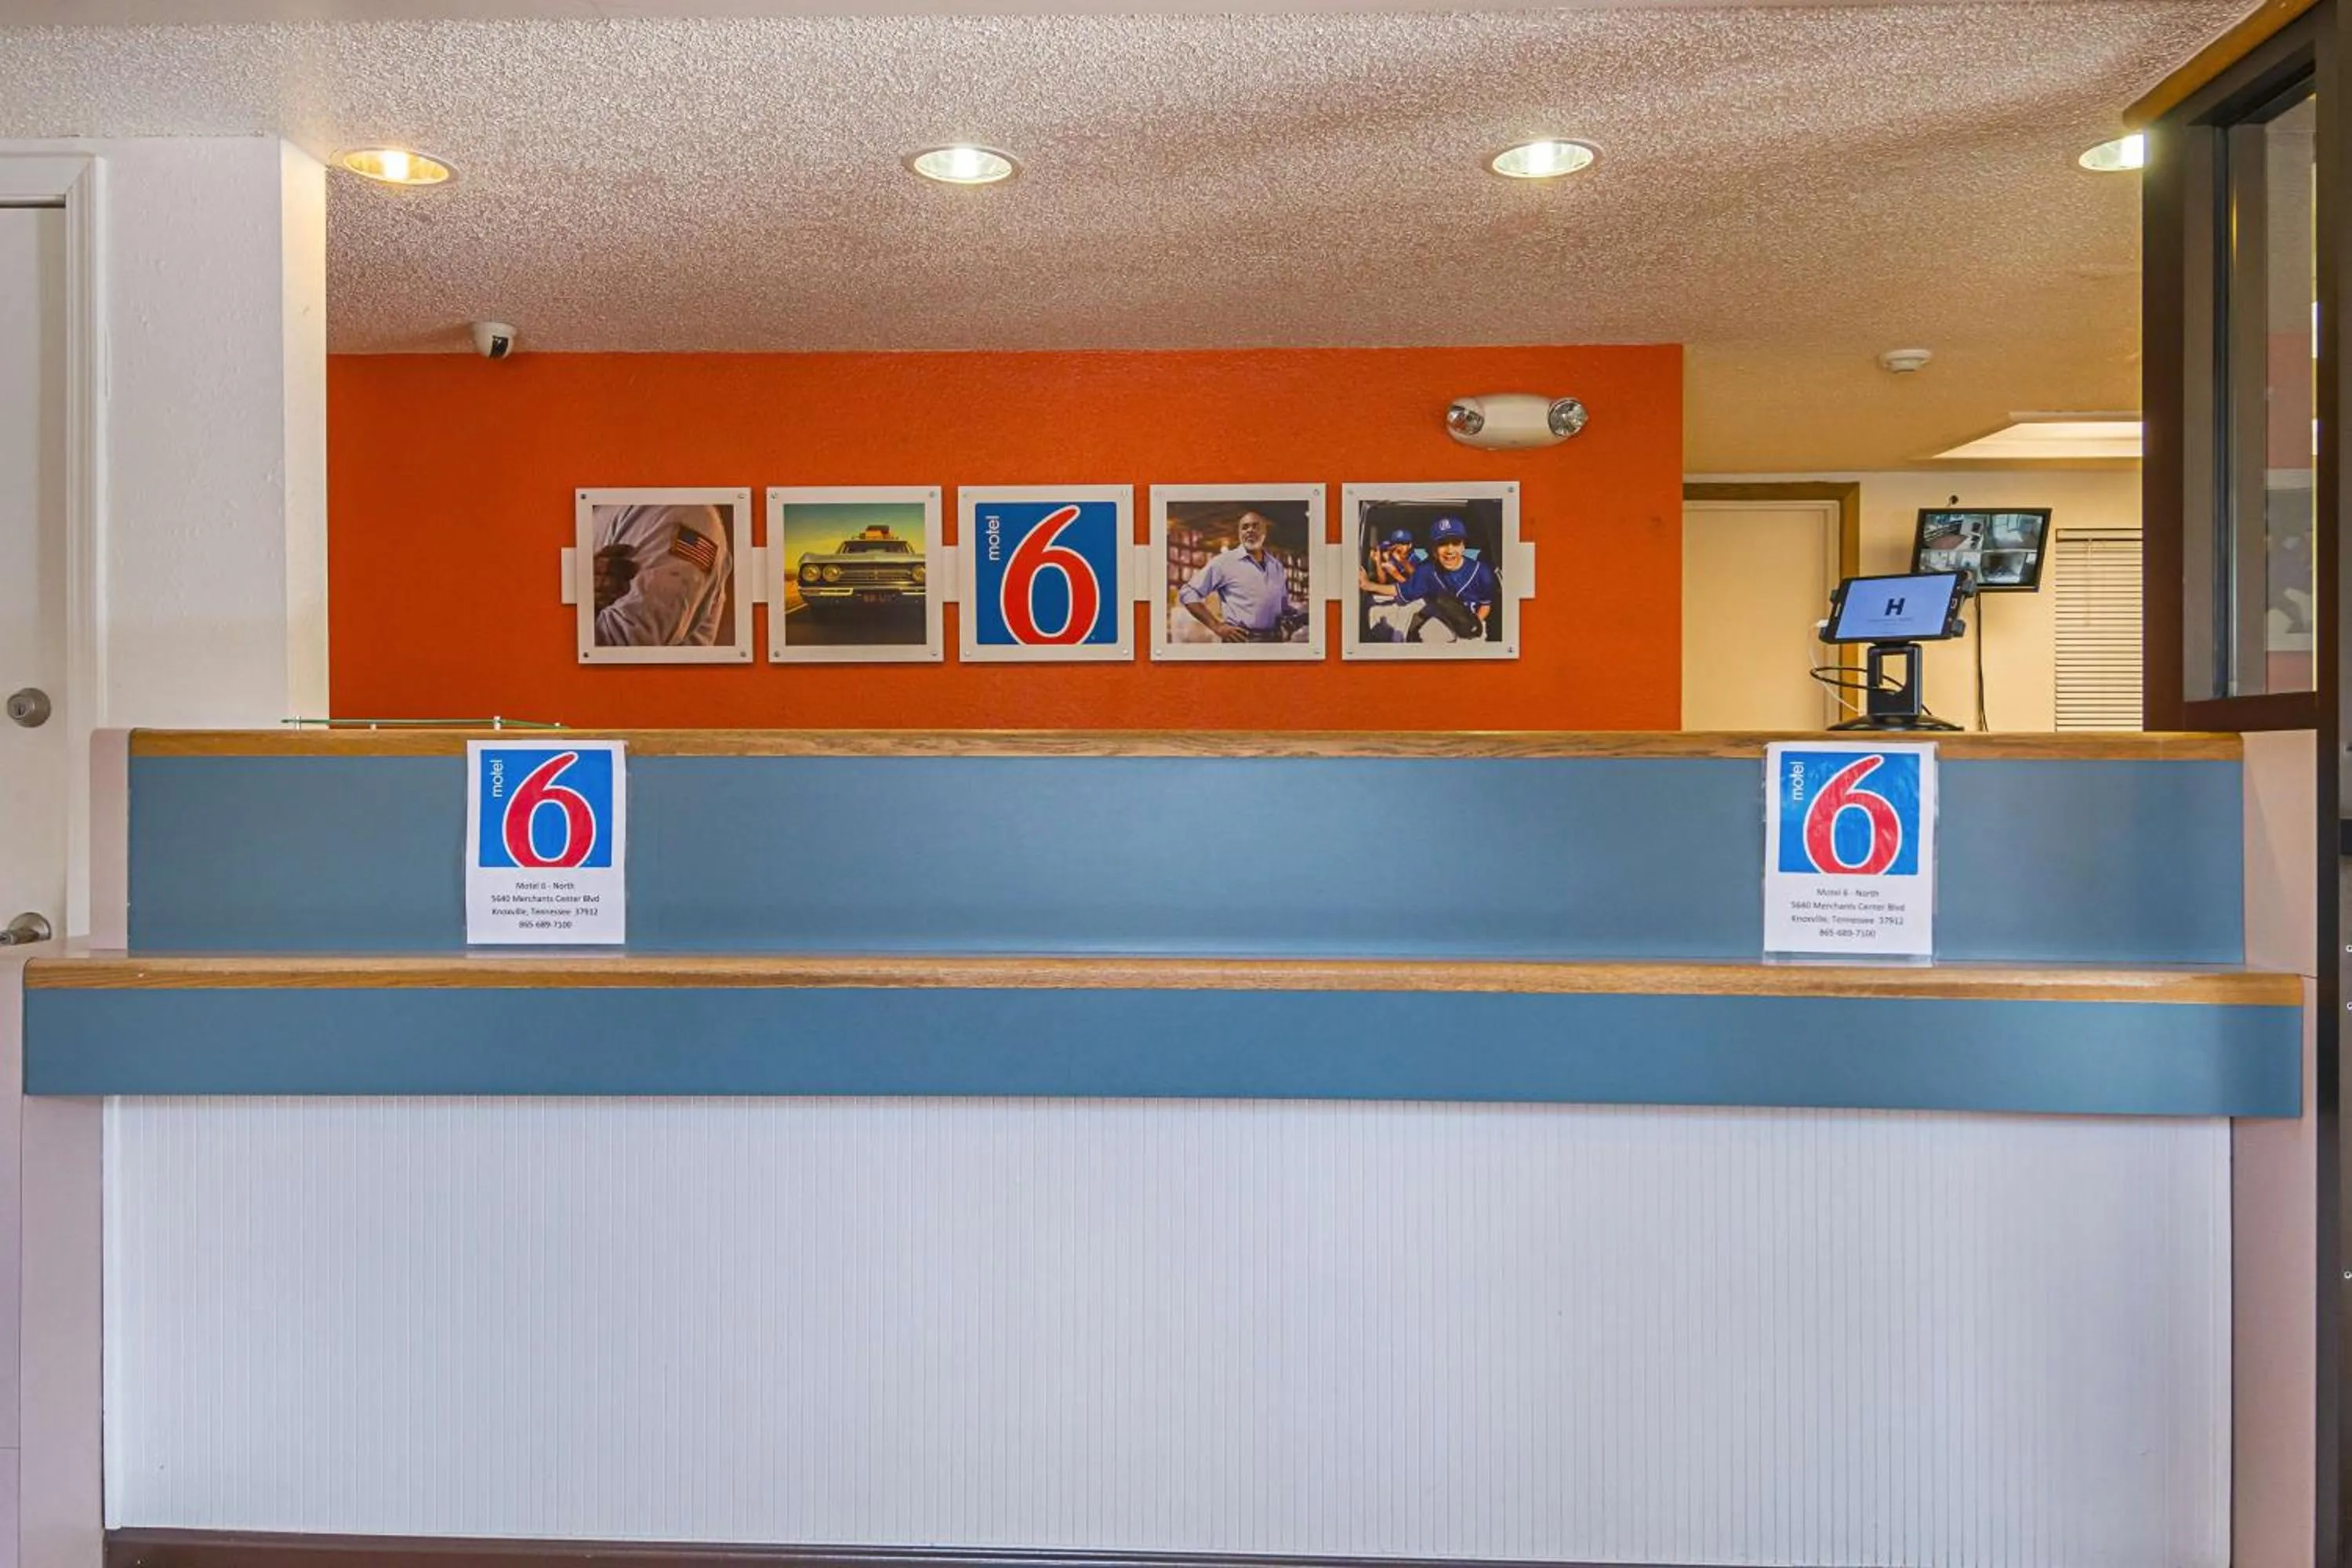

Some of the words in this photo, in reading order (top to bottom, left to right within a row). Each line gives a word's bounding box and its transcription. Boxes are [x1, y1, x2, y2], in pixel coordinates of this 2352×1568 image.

[985, 515, 1000, 562] motel
[1000, 504, 1100, 646] 6
[1884, 597, 1906, 617] H
[489, 759, 503, 798] motel
[1789, 761, 1805, 801] motel
[502, 751, 597, 869] 6
[1803, 754, 1903, 876] 6
[515, 881, 539, 890] Motel
[553, 881, 575, 890] North
[1855, 889, 1879, 898] North
[531, 907, 572, 916] Tennessee
[1887, 903, 1906, 912] Blvd
